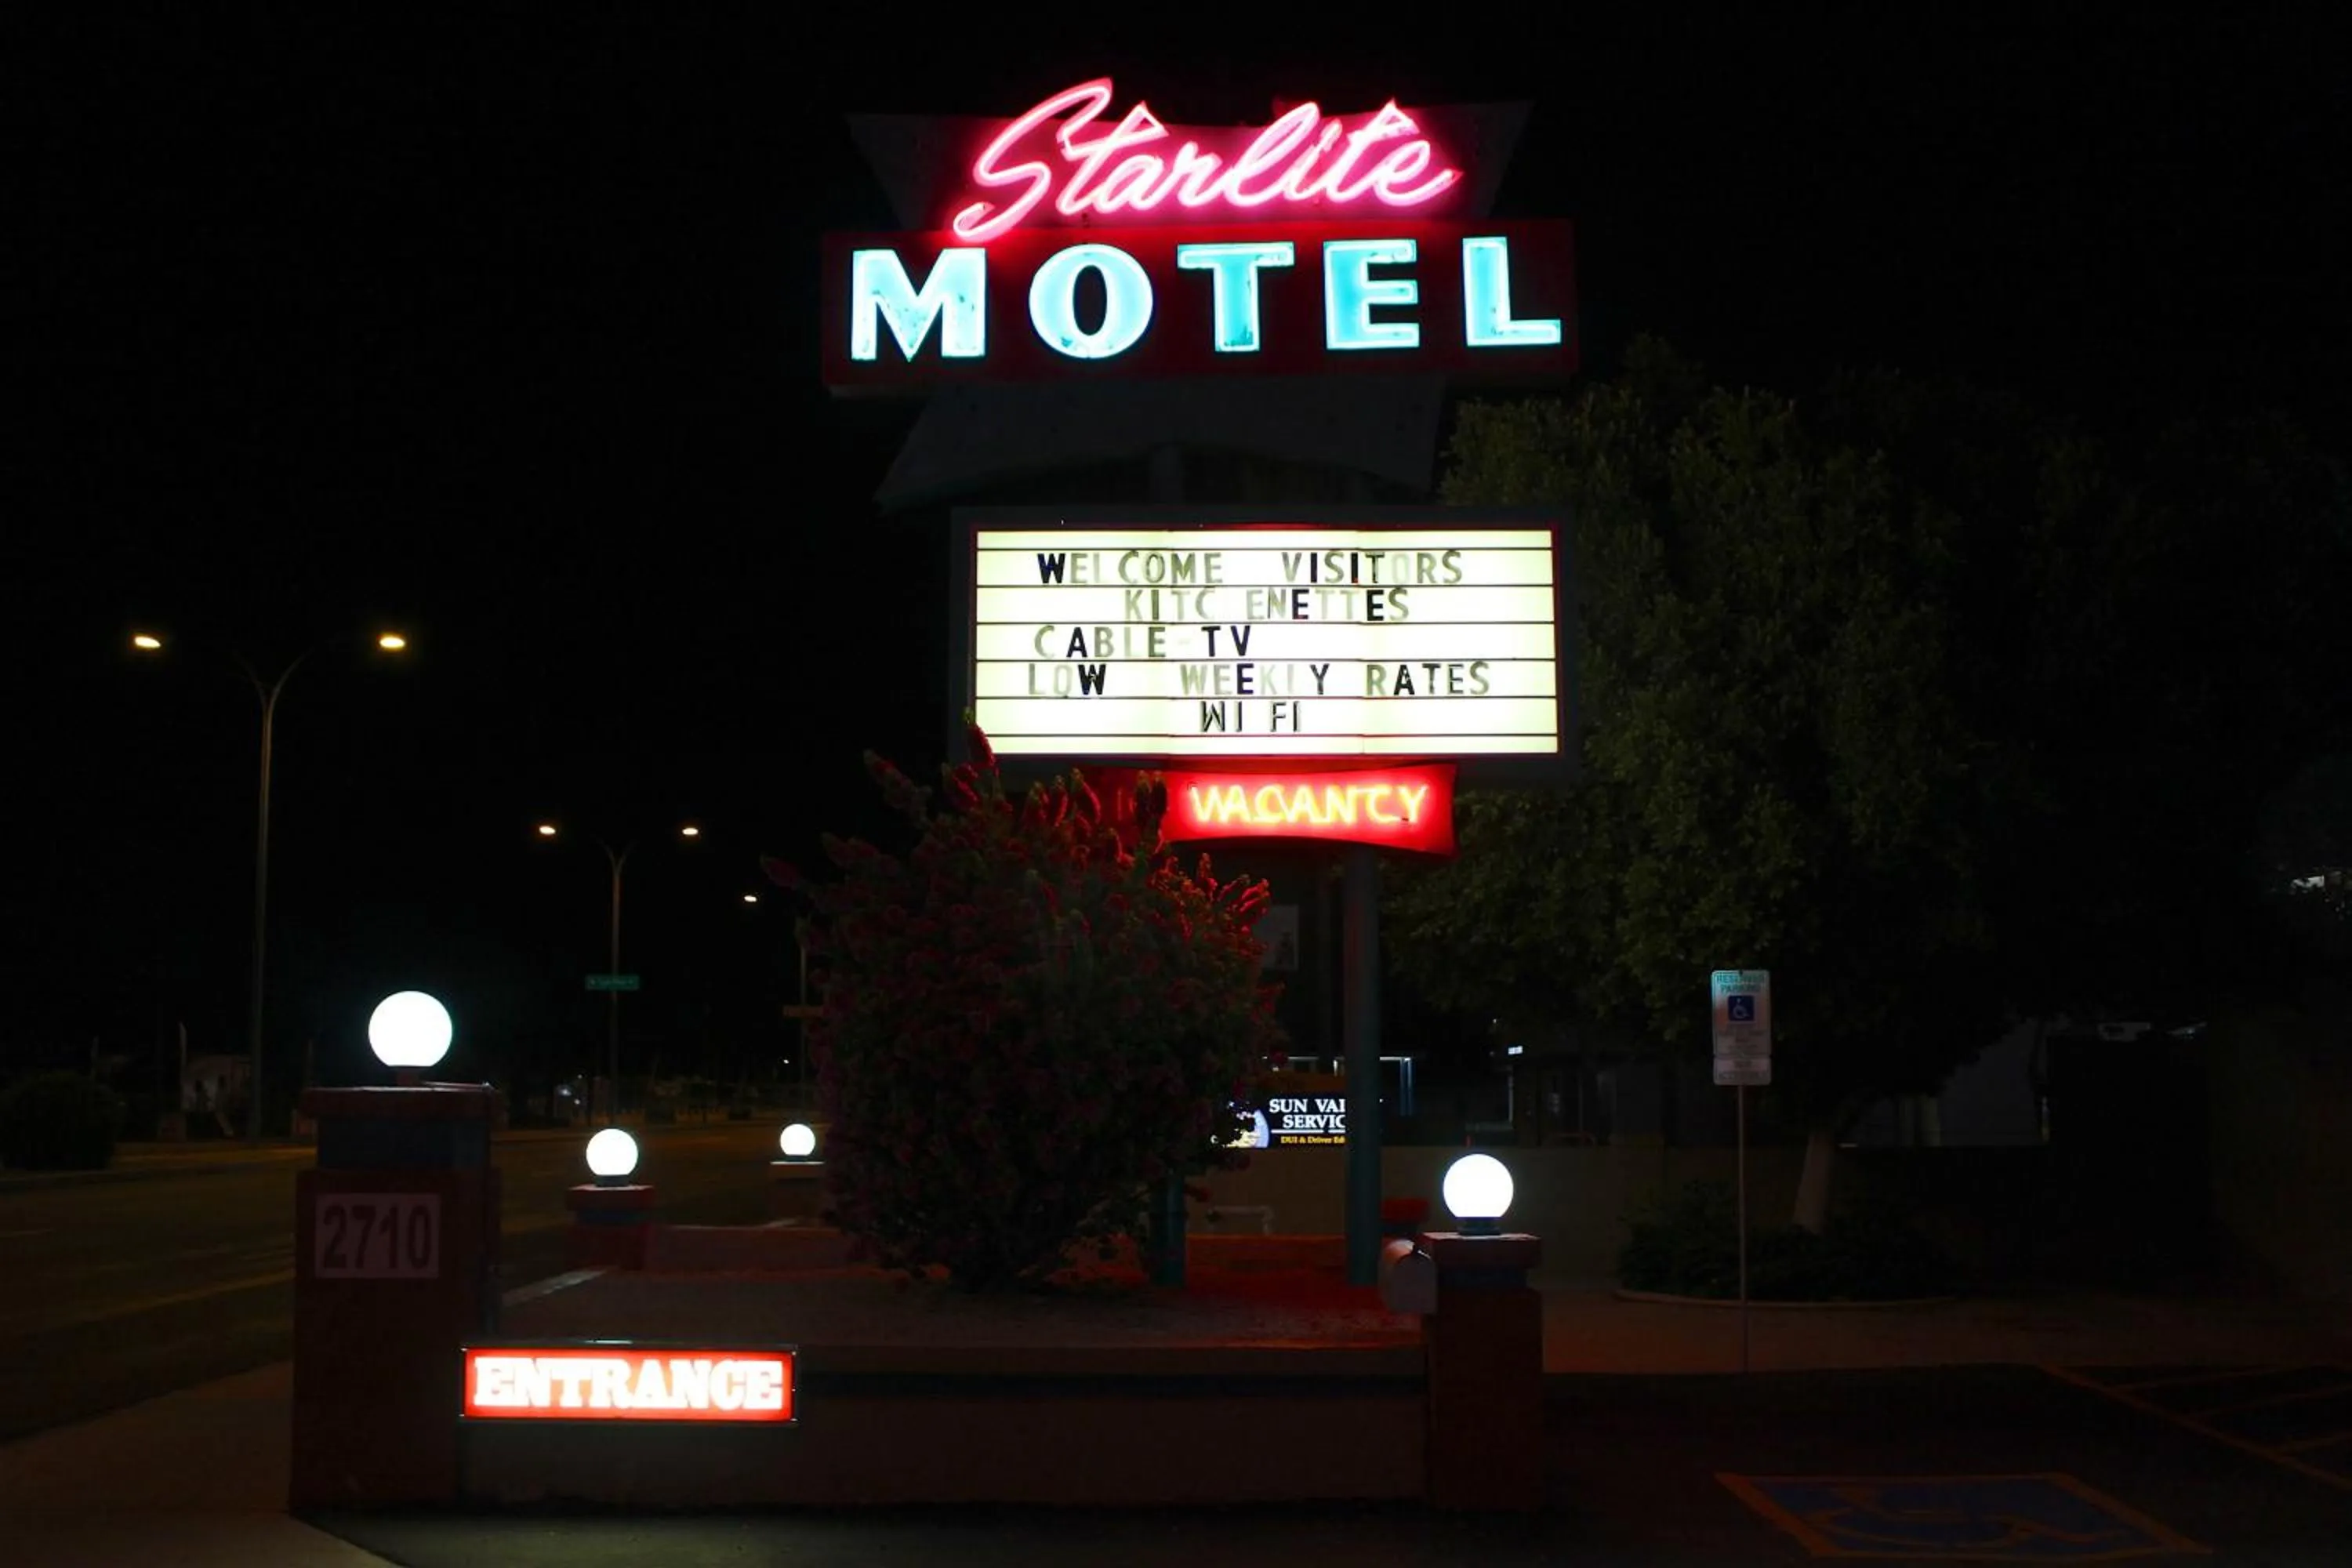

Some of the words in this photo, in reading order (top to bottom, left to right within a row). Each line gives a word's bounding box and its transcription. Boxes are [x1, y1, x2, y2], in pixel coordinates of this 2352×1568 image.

[952, 78, 1461, 243] Starlite
[850, 236, 1563, 362] MOTEL
[1281, 549, 1463, 585] VISITORS
[1123, 587, 1410, 622] KITCENETTES
[1200, 625, 1253, 659] TV
[1028, 662, 1107, 696] LOW
[1366, 661, 1491, 696] RATES
[1188, 782, 1429, 826] VACANCY
[1269, 1098, 1308, 1113] SUN
[323, 1205, 431, 1269] 2710
[474, 1356, 783, 1410] ENTRANCE
